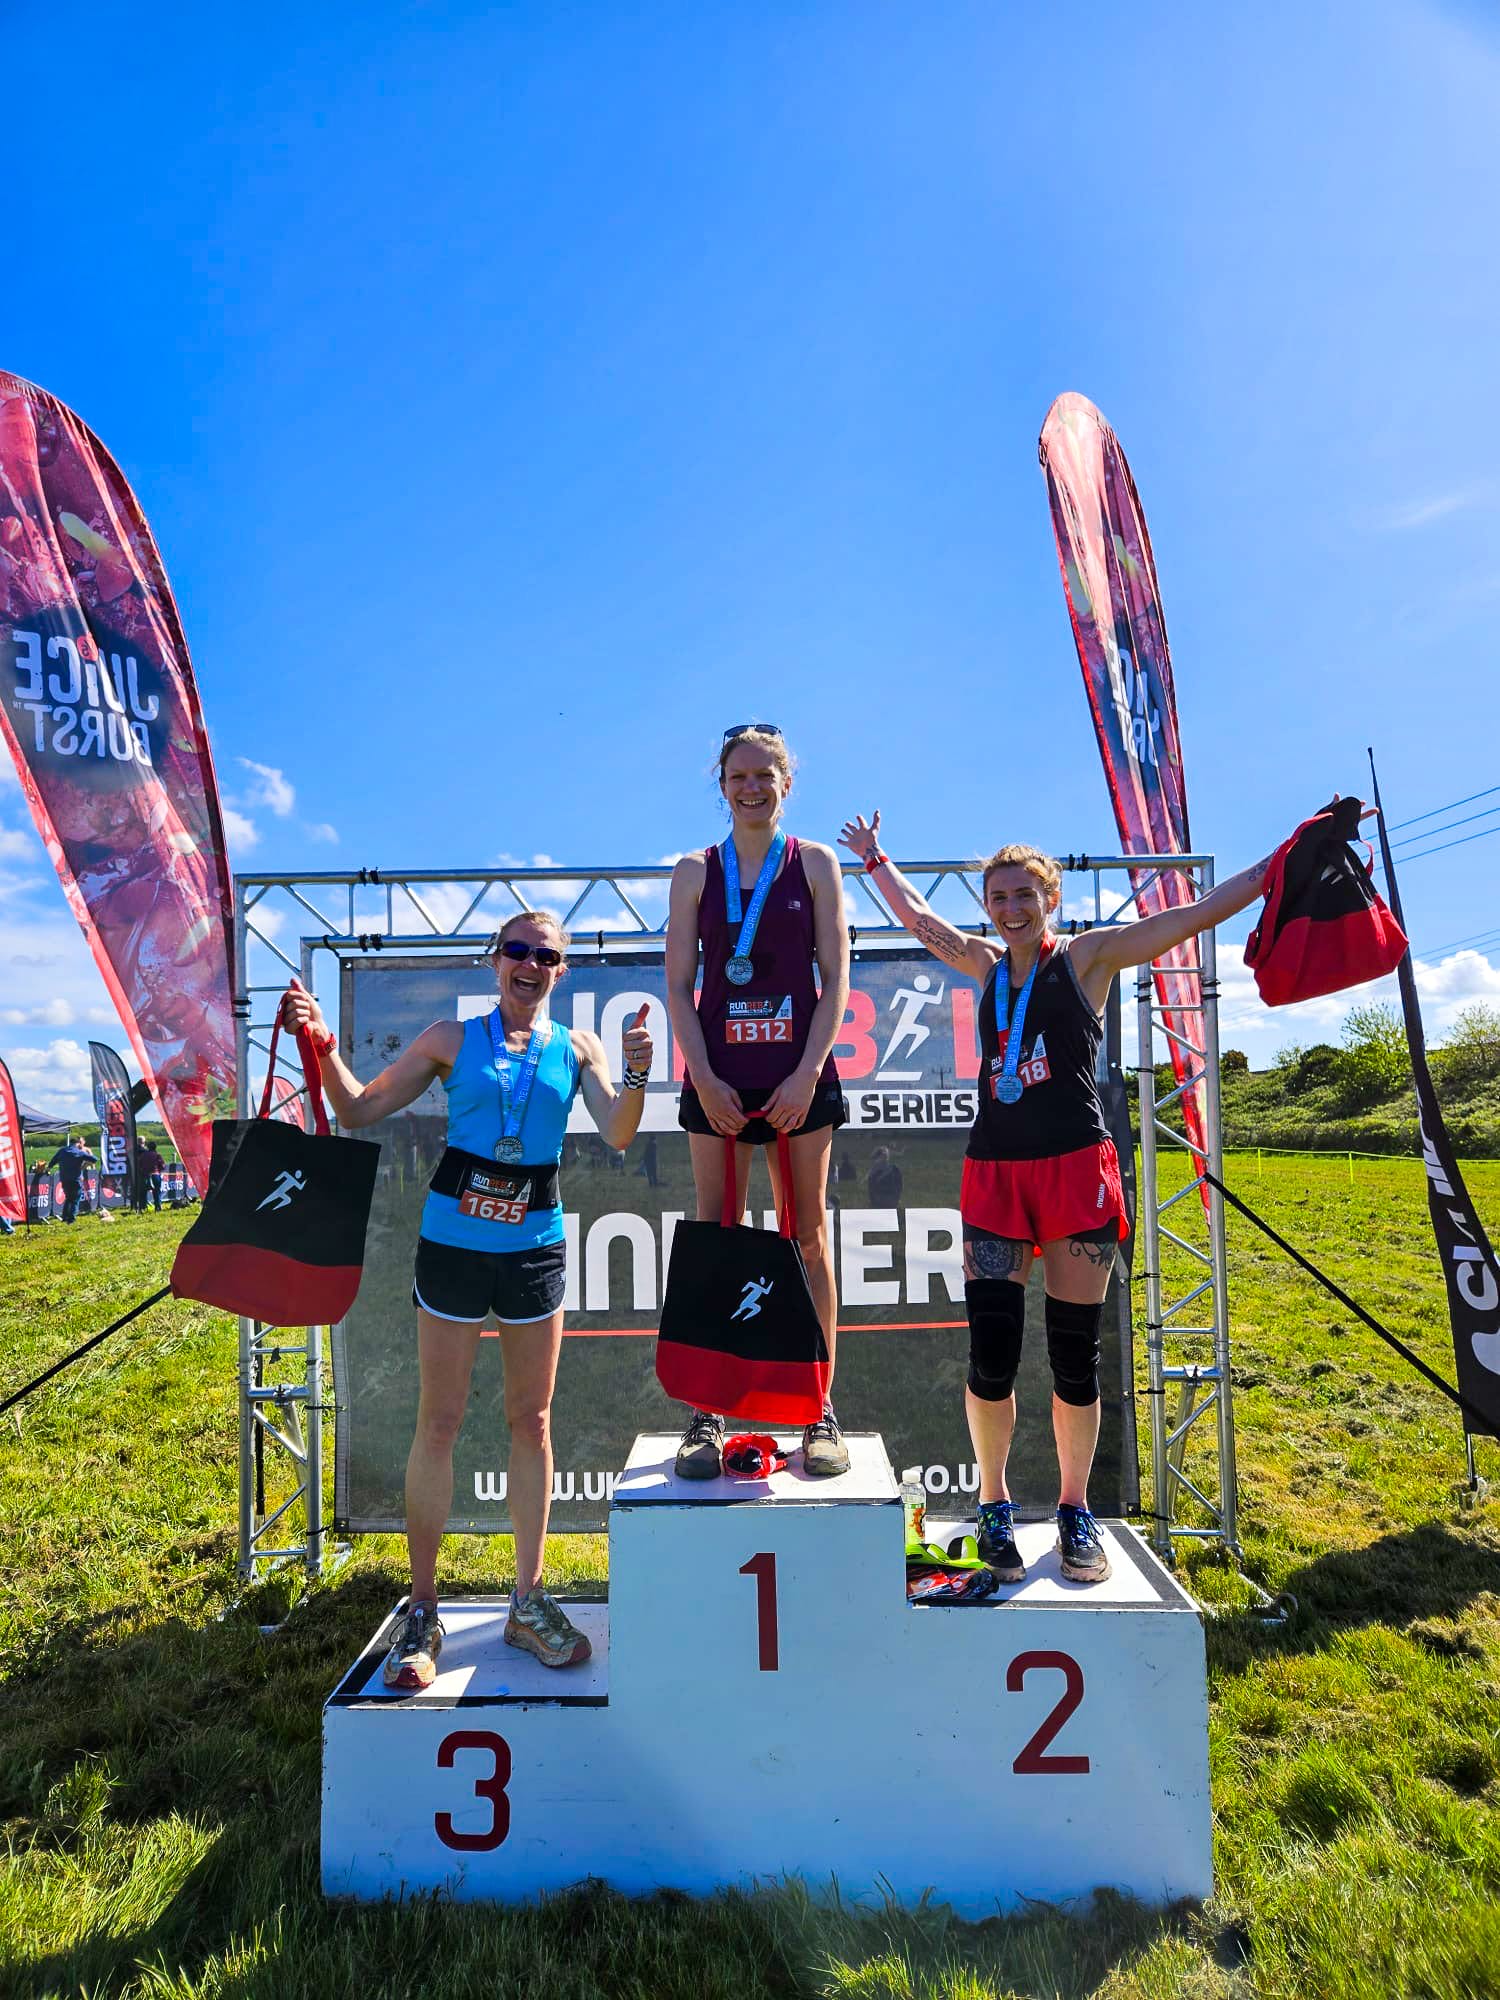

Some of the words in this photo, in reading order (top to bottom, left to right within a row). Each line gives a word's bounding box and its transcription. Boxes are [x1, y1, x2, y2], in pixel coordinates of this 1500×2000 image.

[732, 1021, 786, 1041] 1312
[861, 1093, 975, 1123] SERIES
[468, 1197, 523, 1223] 1625
[739, 1552, 779, 1671] 1
[1006, 1650, 1090, 1774] 2
[435, 1731, 512, 1851] 3
